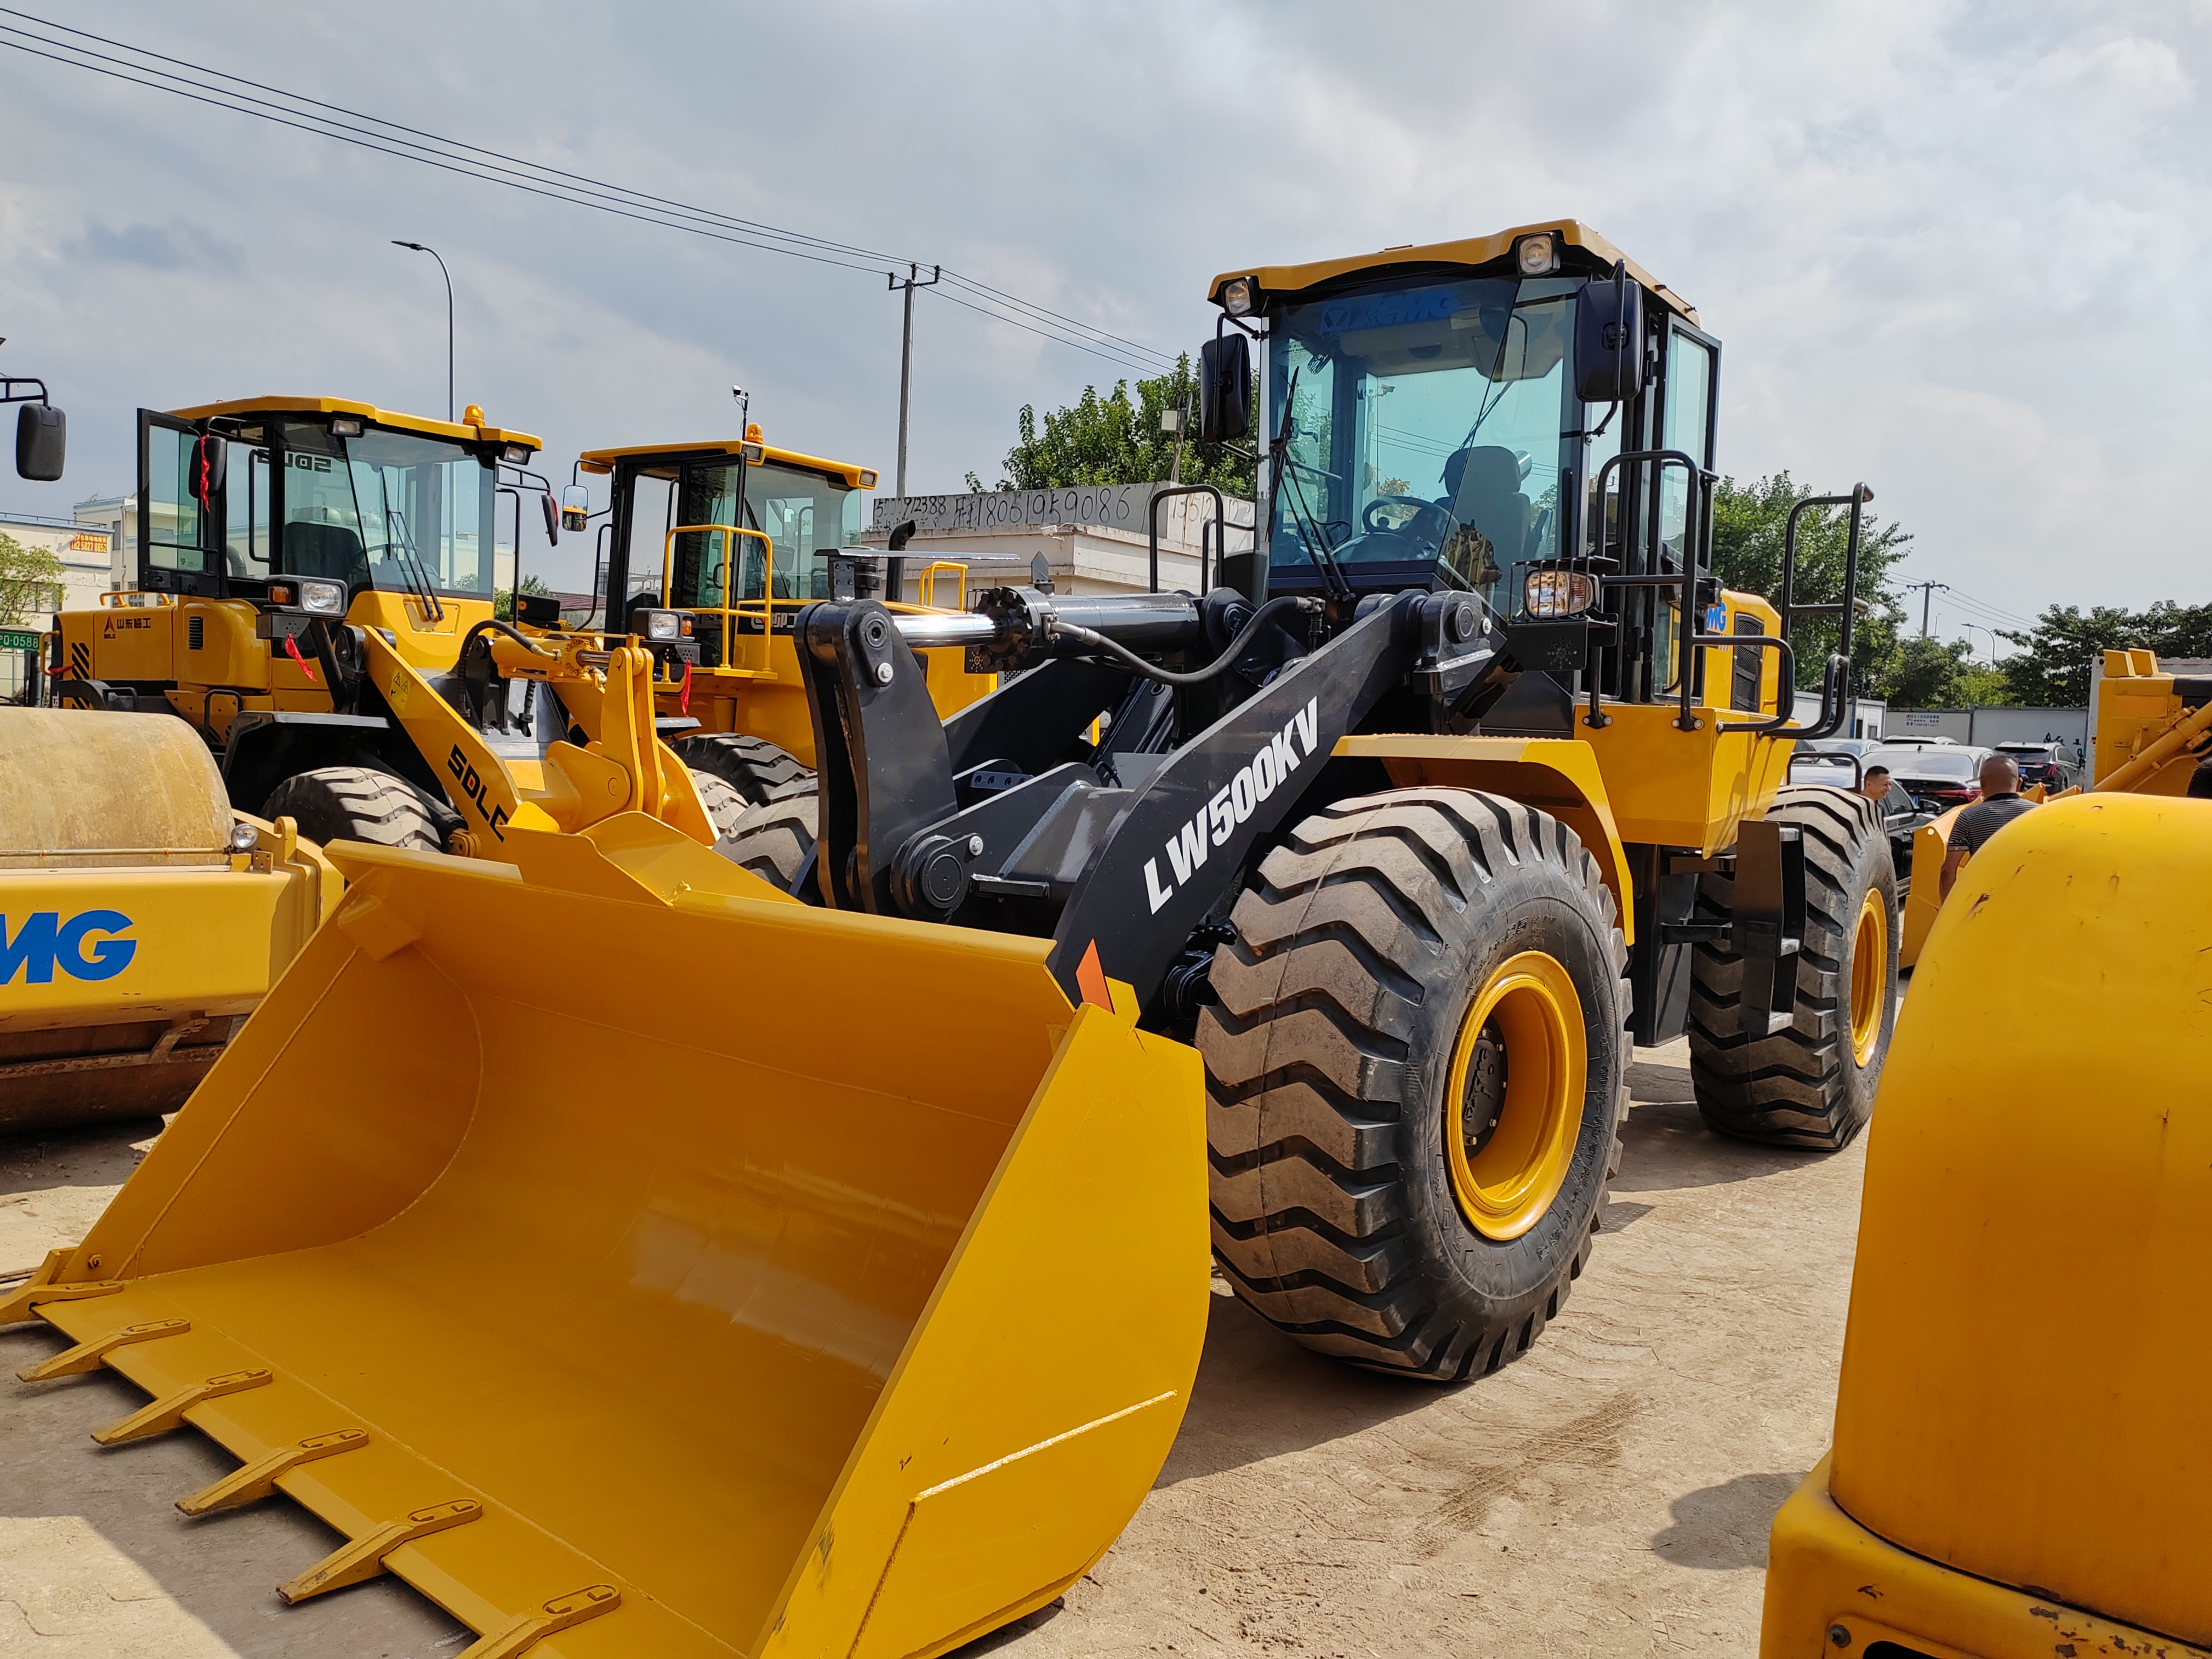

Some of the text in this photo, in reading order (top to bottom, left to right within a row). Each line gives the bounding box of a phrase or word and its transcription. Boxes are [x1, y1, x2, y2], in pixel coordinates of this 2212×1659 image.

[117, 617, 151, 629] 山东临工
[1143, 696, 1318, 915] LW500KV
